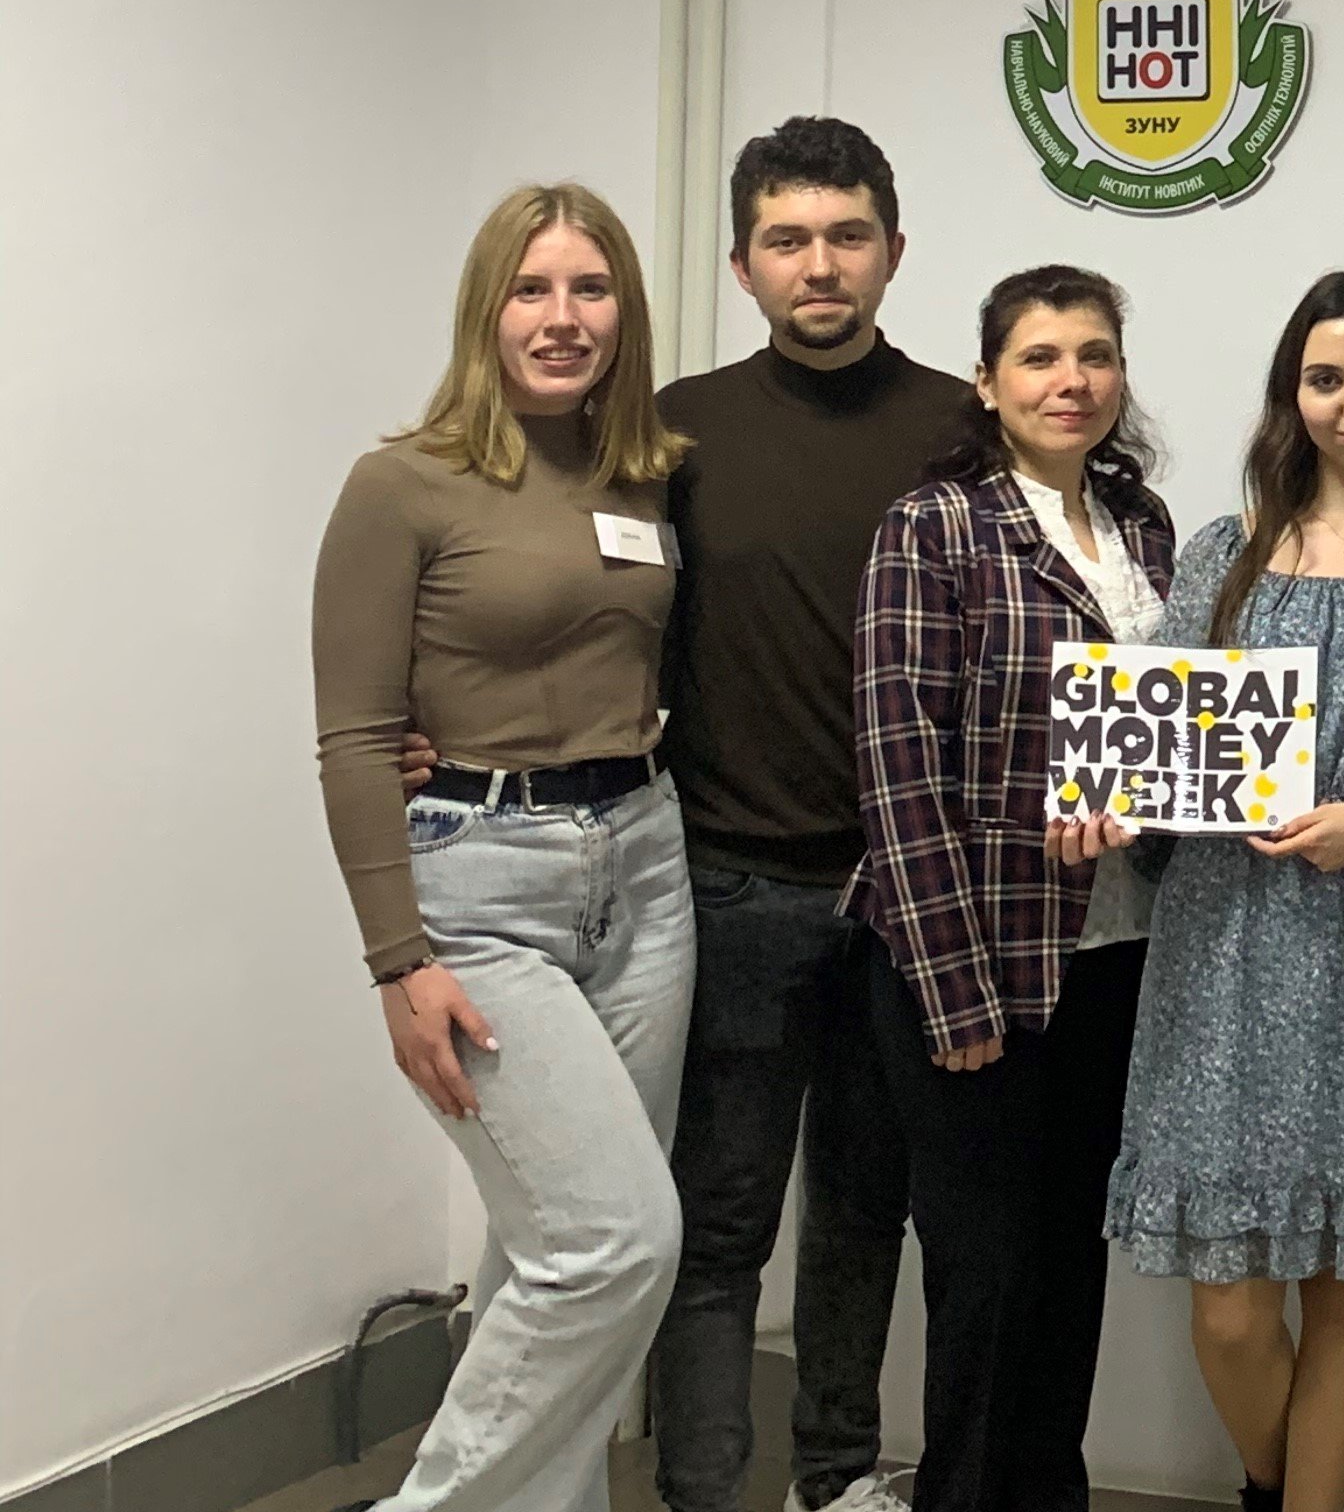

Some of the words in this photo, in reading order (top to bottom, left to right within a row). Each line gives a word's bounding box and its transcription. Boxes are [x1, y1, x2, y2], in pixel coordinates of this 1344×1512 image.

[1106, 4, 1199, 49] ННІ
[1106, 50, 1199, 89] НОТ
[1010, 40, 1070, 168] НАВЧАЛЬНО-НАУКОВИЙ
[1098, 174, 1151, 199] ІНСТИТУТ
[1154, 173, 1206, 199] НОВІТНІХ
[1244, 104, 1283, 154] ОСВІТНІХ
[1272, 34, 1297, 106] ТЕХНОЛОГІЙ
[1125, 117, 1180, 134] ЗУНУ
[1050, 663, 1316, 719] GLOBAL
[1051, 715, 1293, 771] MONEY
[1050, 765, 1247, 822] WEEK
